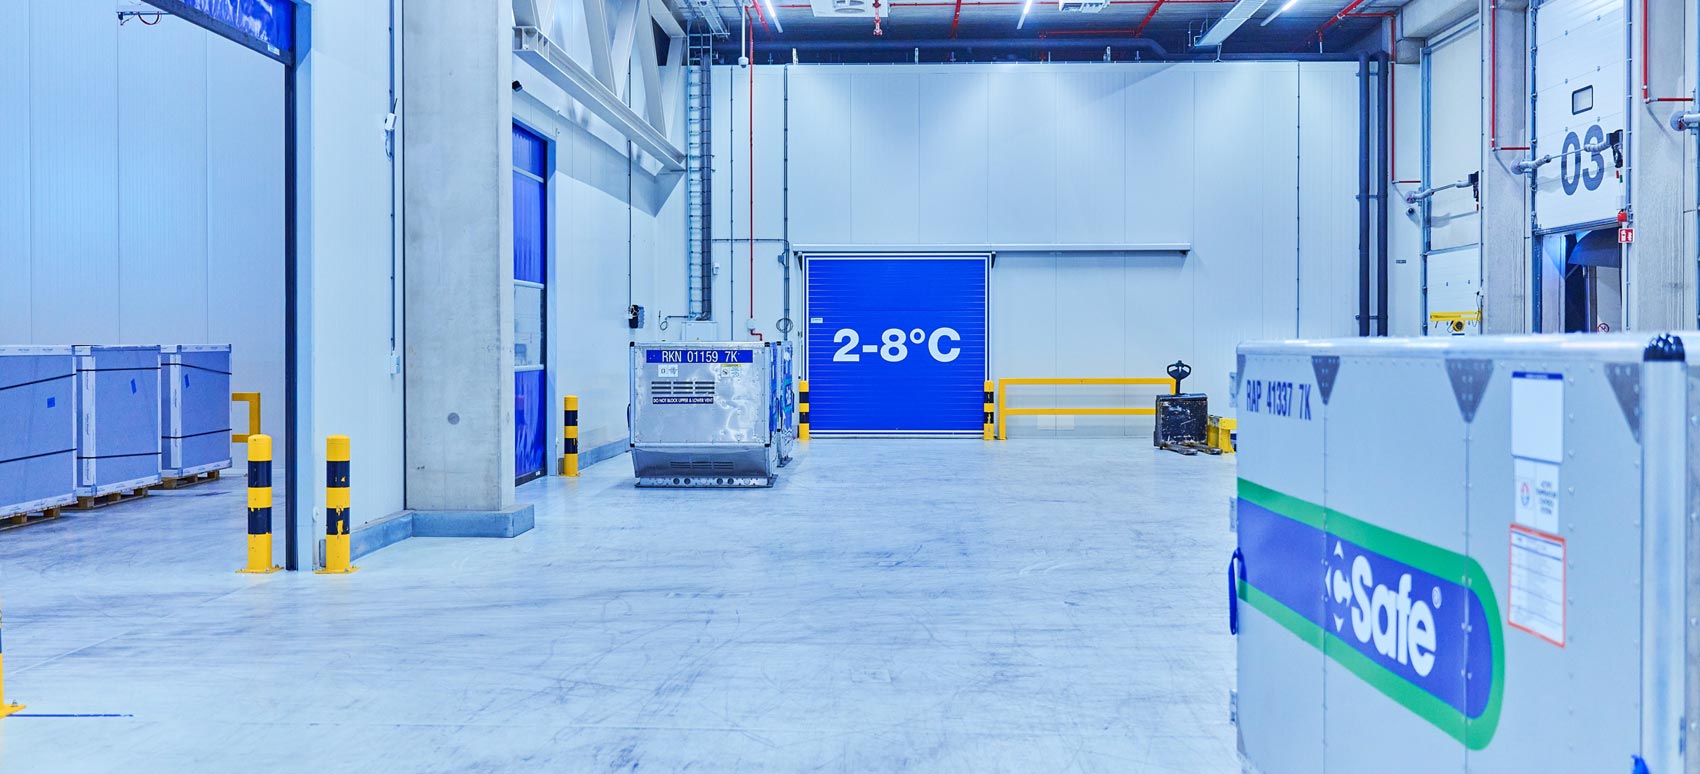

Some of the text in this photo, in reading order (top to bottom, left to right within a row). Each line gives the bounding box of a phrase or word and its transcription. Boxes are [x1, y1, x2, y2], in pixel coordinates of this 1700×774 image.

[1561, 124, 1605, 196] 03
[662, 351, 738, 363] RKN 01159 7K
[833, 327, 961, 363] 2-8°C
[1246, 380, 1312, 421] RAP 41337 7K
